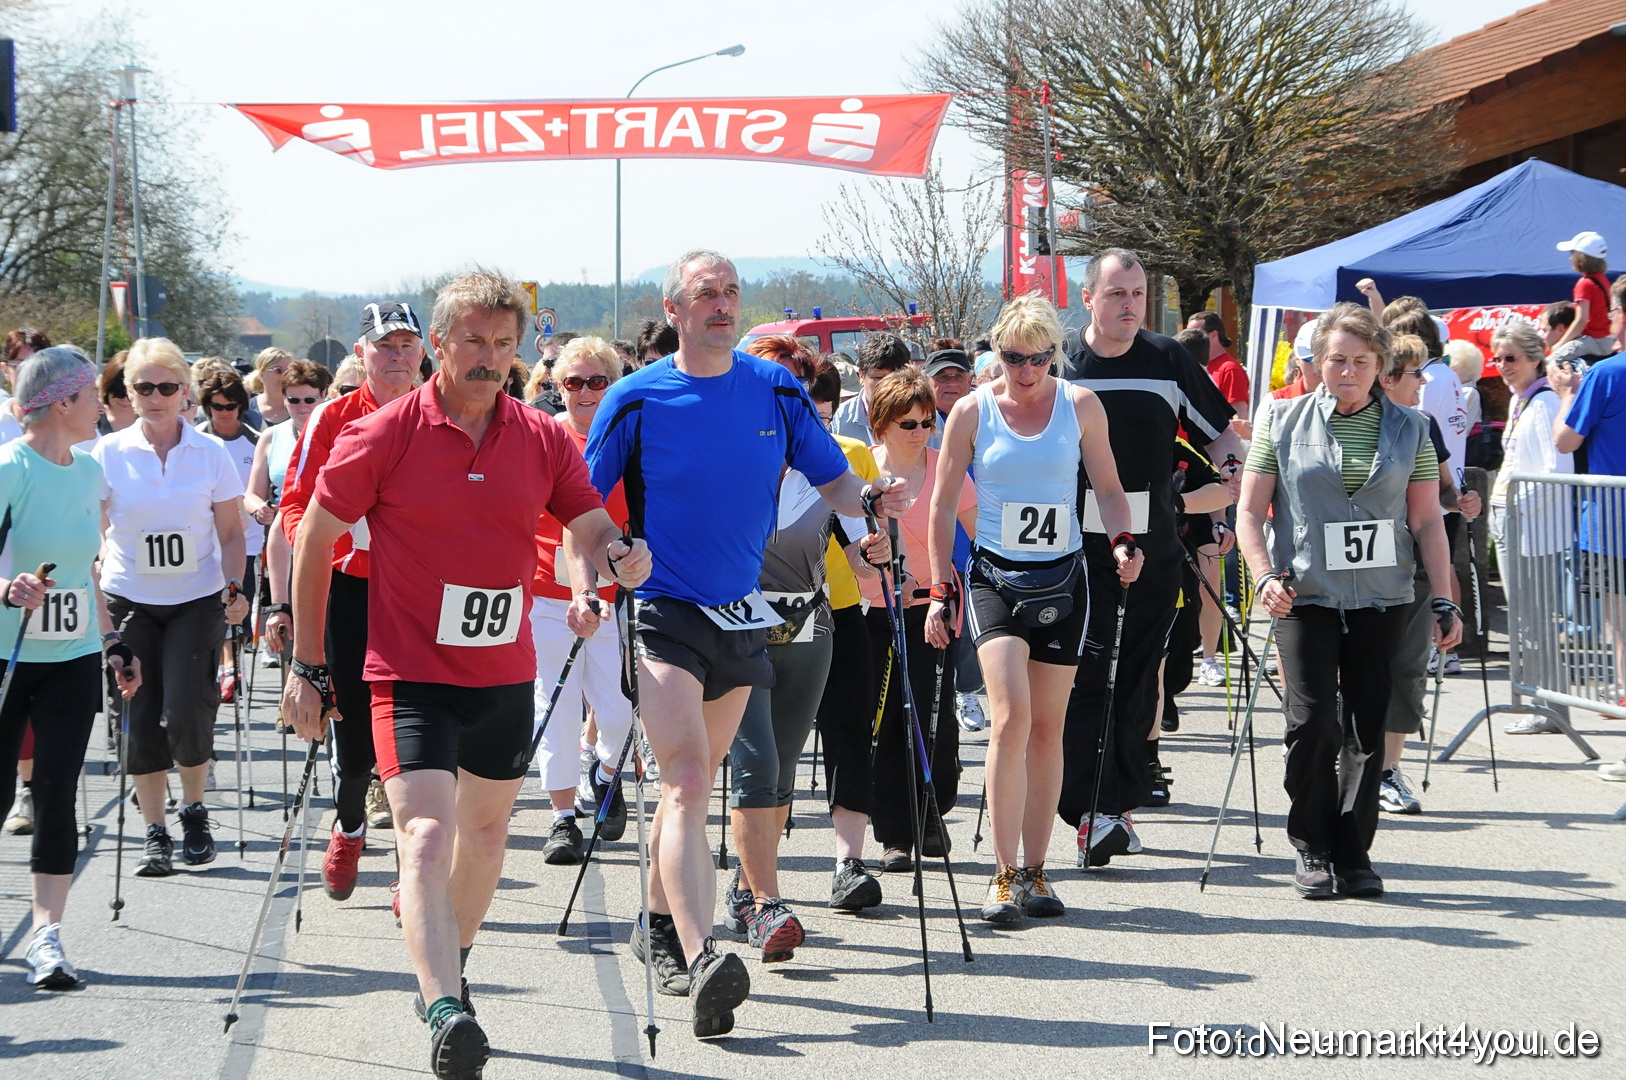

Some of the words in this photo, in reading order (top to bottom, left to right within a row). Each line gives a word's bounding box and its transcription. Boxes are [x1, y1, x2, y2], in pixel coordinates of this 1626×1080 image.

[540, 315, 553, 327] 60
[1018, 506, 1058, 546] 24
[1343, 523, 1378, 564] 57
[145, 533, 184, 567] 110
[41, 591, 78, 633] 113
[461, 590, 512, 638] 99
